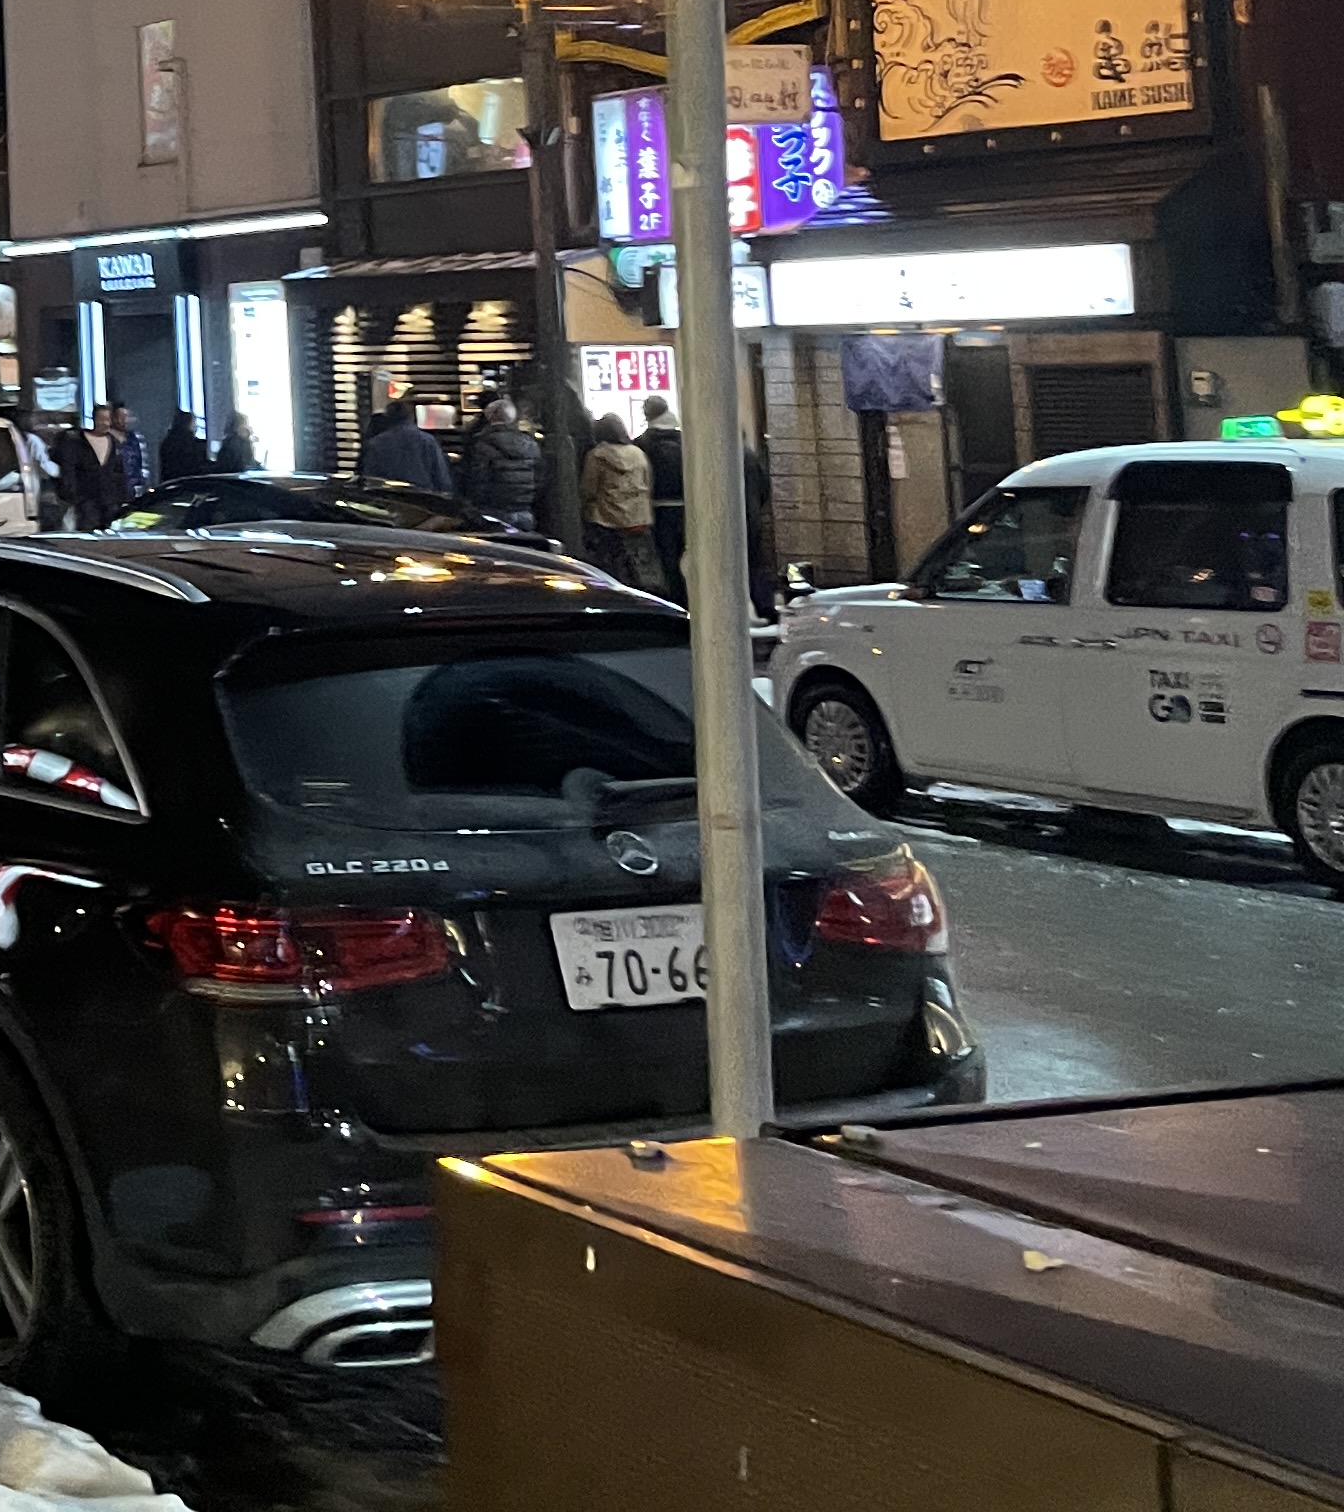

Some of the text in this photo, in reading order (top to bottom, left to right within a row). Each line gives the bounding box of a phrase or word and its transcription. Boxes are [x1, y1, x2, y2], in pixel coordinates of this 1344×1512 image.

[1091, 82, 1192, 111] KAME SUSHI
[639, 213, 663, 231] 2F
[1179, 629, 1242, 648] TAXI
[306, 857, 450, 876] GLC 220d
